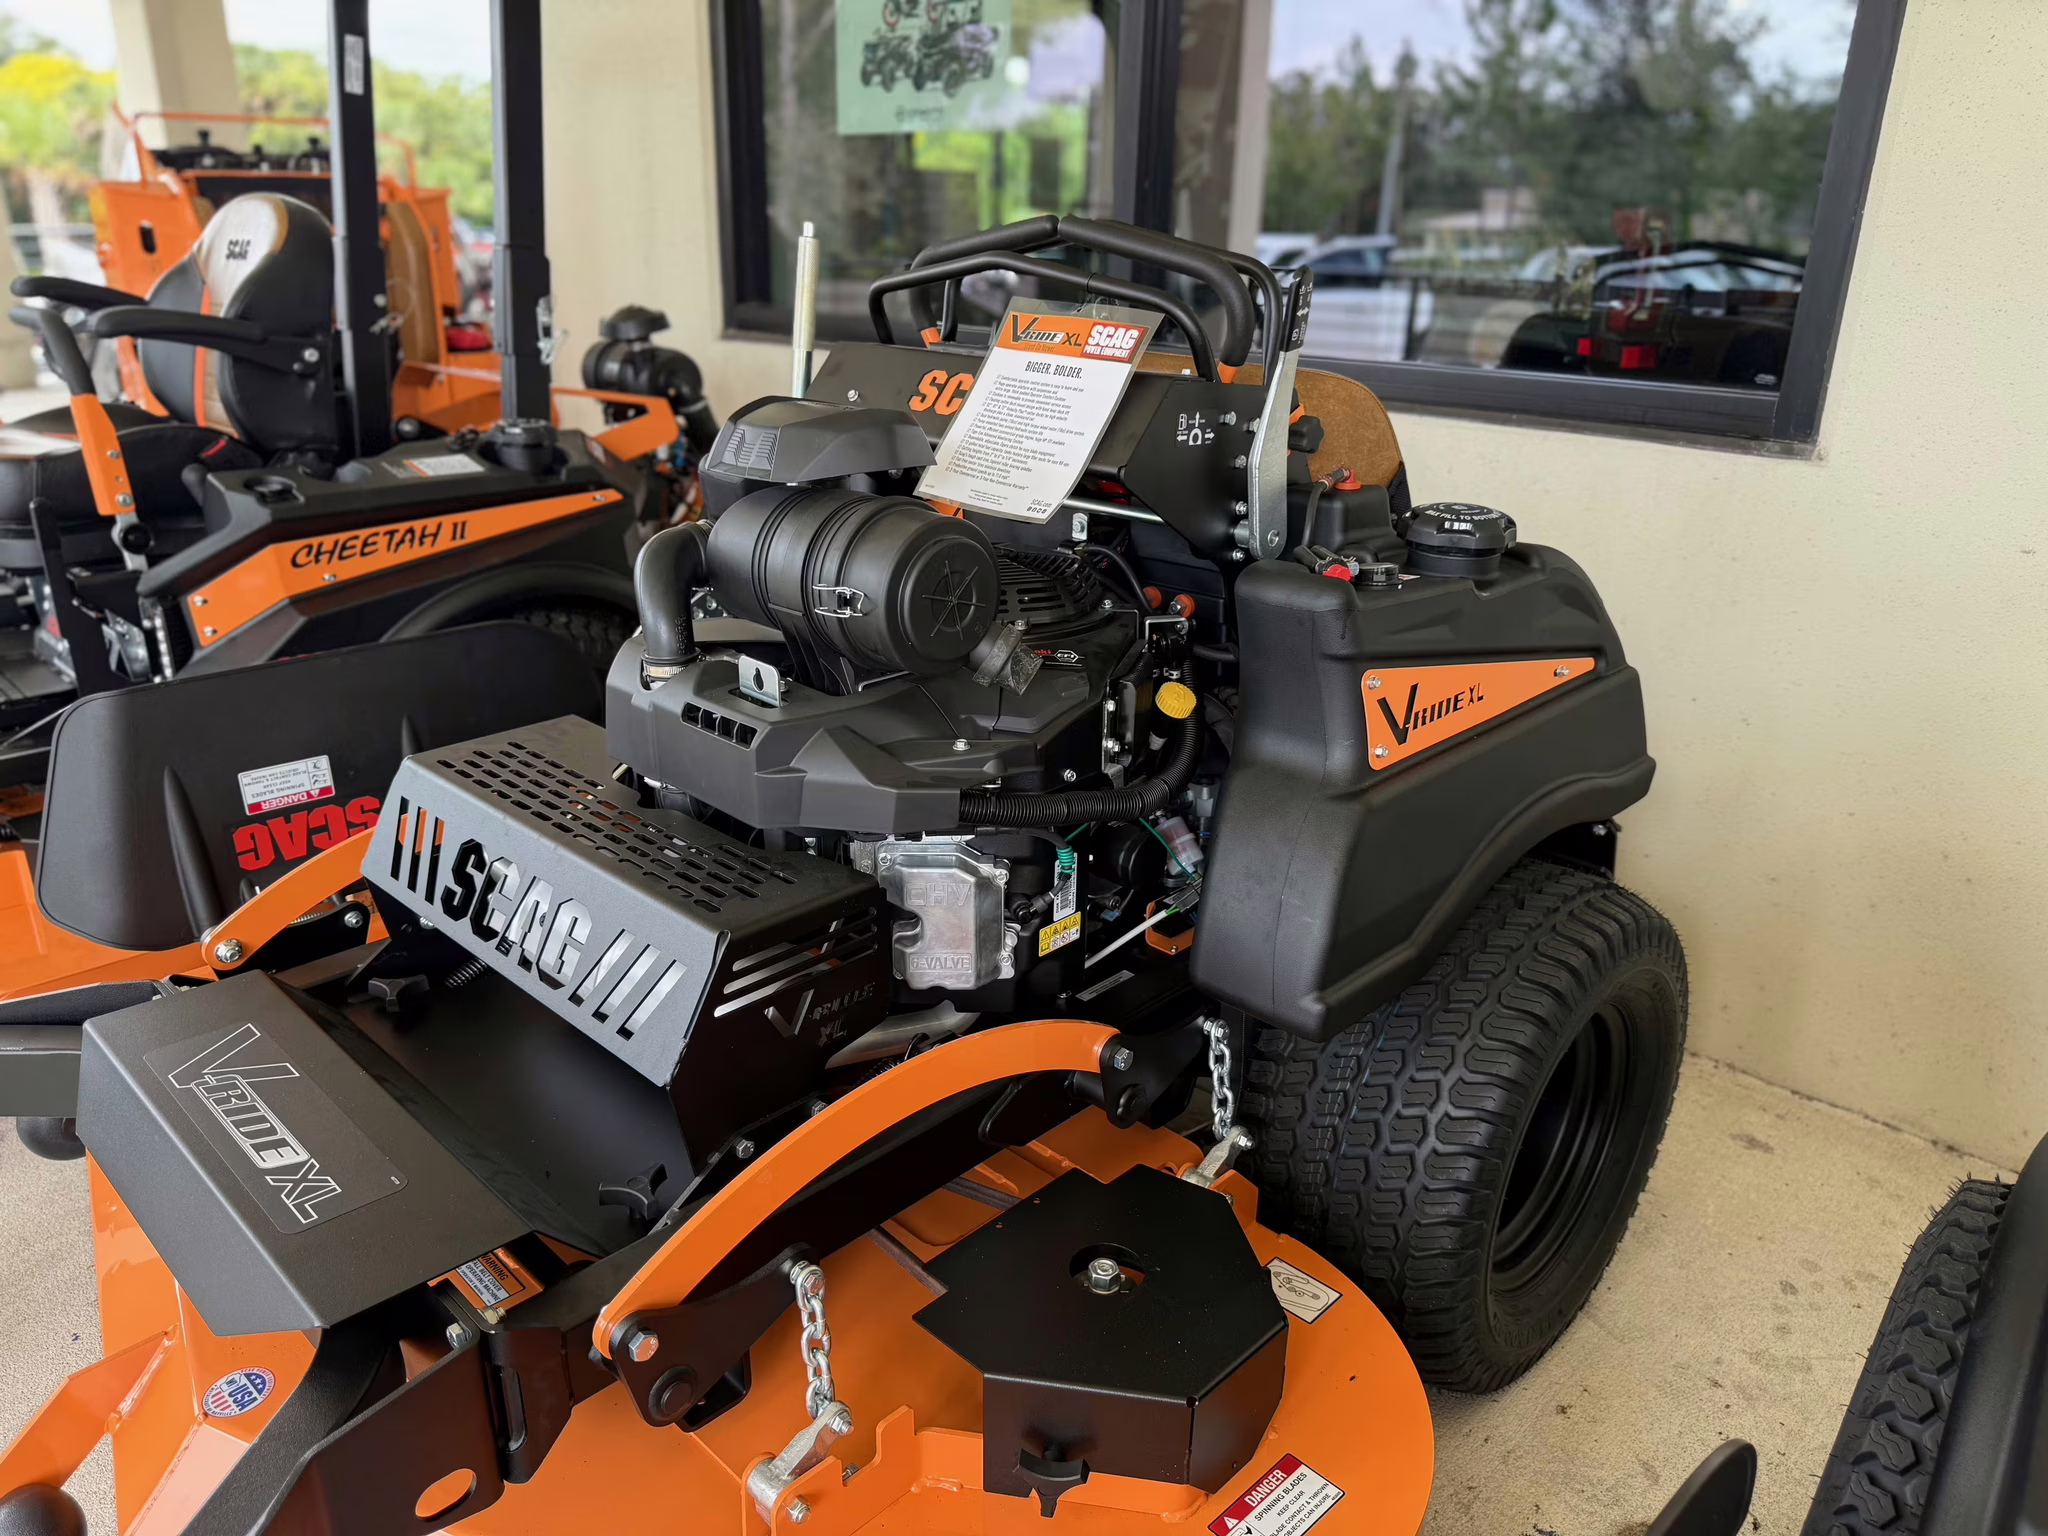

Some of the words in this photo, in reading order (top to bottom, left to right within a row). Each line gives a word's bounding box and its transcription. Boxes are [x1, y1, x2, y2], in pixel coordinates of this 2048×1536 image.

[1062, 332, 1082, 347] XL
[1088, 325, 1139, 349] SCAG
[1025, 361, 1051, 374] BIGGER.
[1054, 365, 1082, 378] BOLDER.
[908, 369, 975, 416] SC
[291, 521, 442, 568] CHEETAH
[451, 521, 467, 541] II
[1467, 682, 1484, 706] XL
[251, 789, 275, 799] BLADES
[260, 791, 308, 810] DANGER
[276, 782, 305, 793] SPINNING
[232, 796, 380, 871] SCAG
[906, 882, 970, 906] OHV
[440, 838, 592, 990] SCAG
[911, 955, 970, 970] 6-VALVE
[264, 1158, 342, 1223] XL
[466, 1264, 485, 1286] OPERATING
[485, 1284, 501, 1301] MACHINE
[479, 1267, 490, 1279] BELT
[488, 1278, 502, 1292] COVER
[228, 1383, 258, 1412] USA
[1244, 1469, 1287, 1507] DANGER
[1254, 1494, 1284, 1521] SPINNING
[1282, 1472, 1307, 1495] BLADES
[1276, 1504, 1290, 1517] KEEP
[1289, 1490, 1306, 1505] CLEAR
[1285, 1504, 1307, 1524] CONTACT
[1308, 1482, 1329, 1501] THROWN
[1304, 1508, 1315, 1519] CAN
[1314, 1493, 1331, 1509] INJURE
